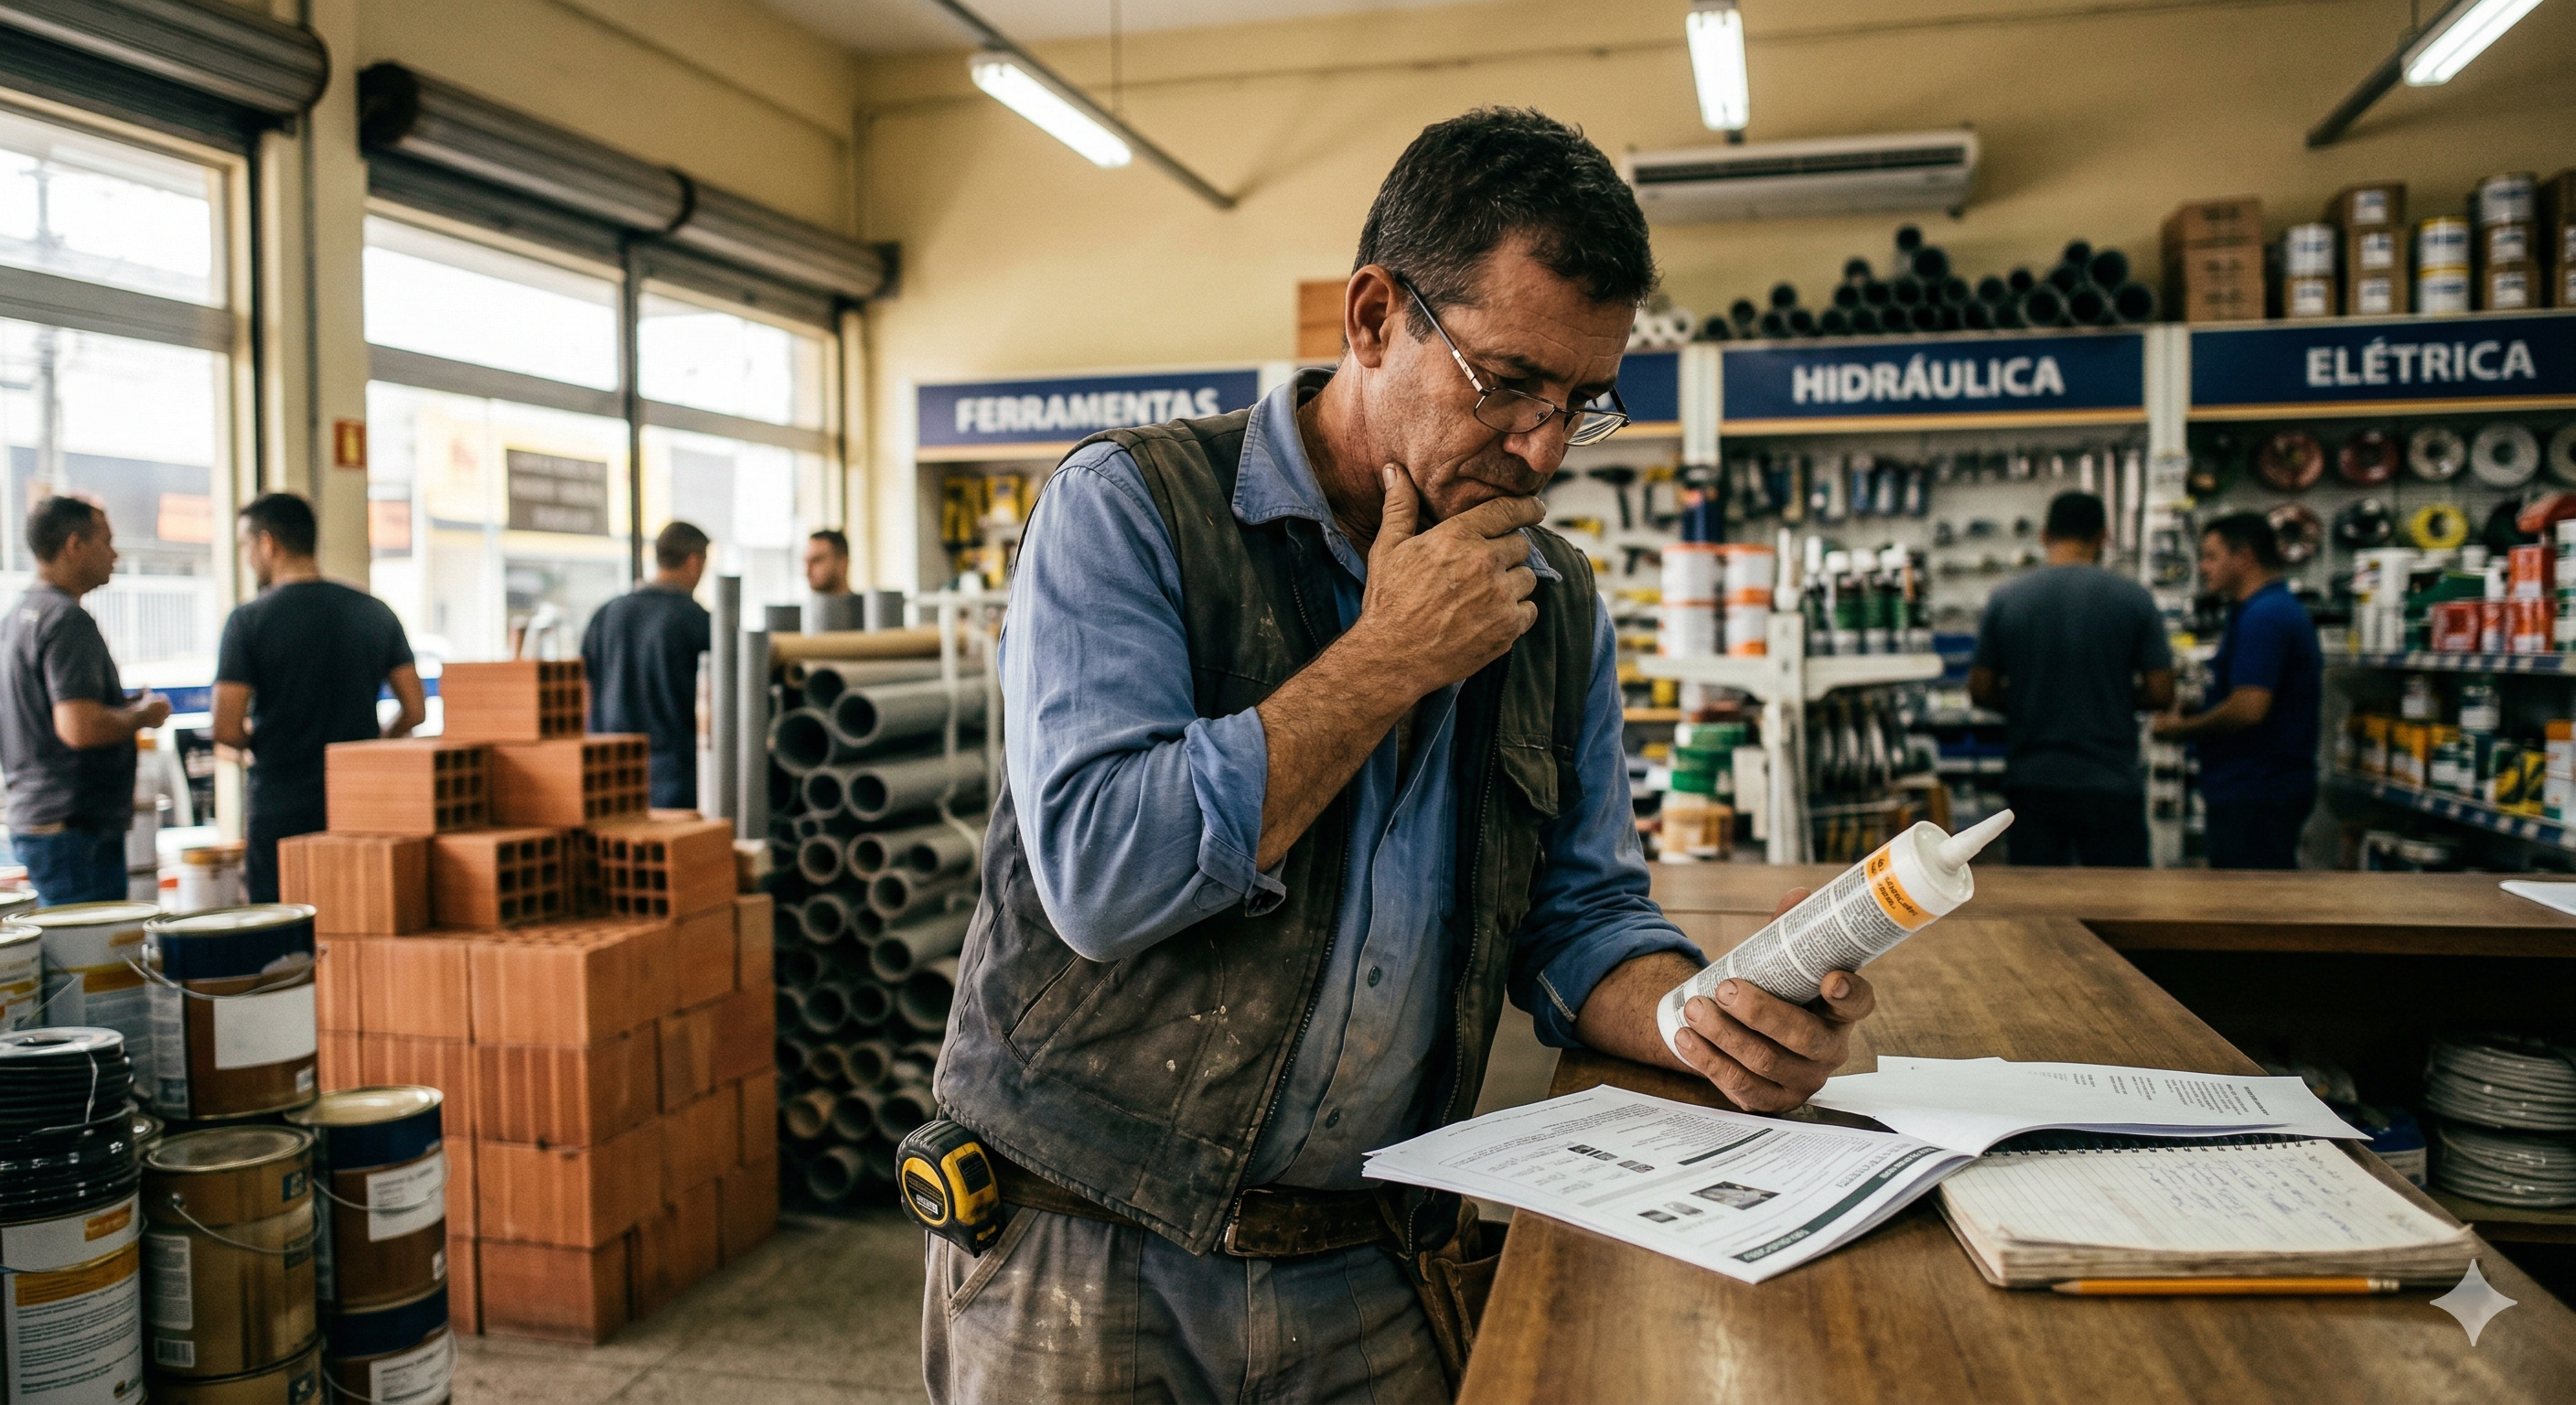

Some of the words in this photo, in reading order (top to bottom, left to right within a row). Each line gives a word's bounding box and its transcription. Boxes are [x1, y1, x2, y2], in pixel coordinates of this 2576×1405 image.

[1791, 351, 2066, 405] HIDRÁULICA
[2305, 335, 2538, 388] ELÉTRICA
[954, 386, 1221, 434] FERRAMENTAS
